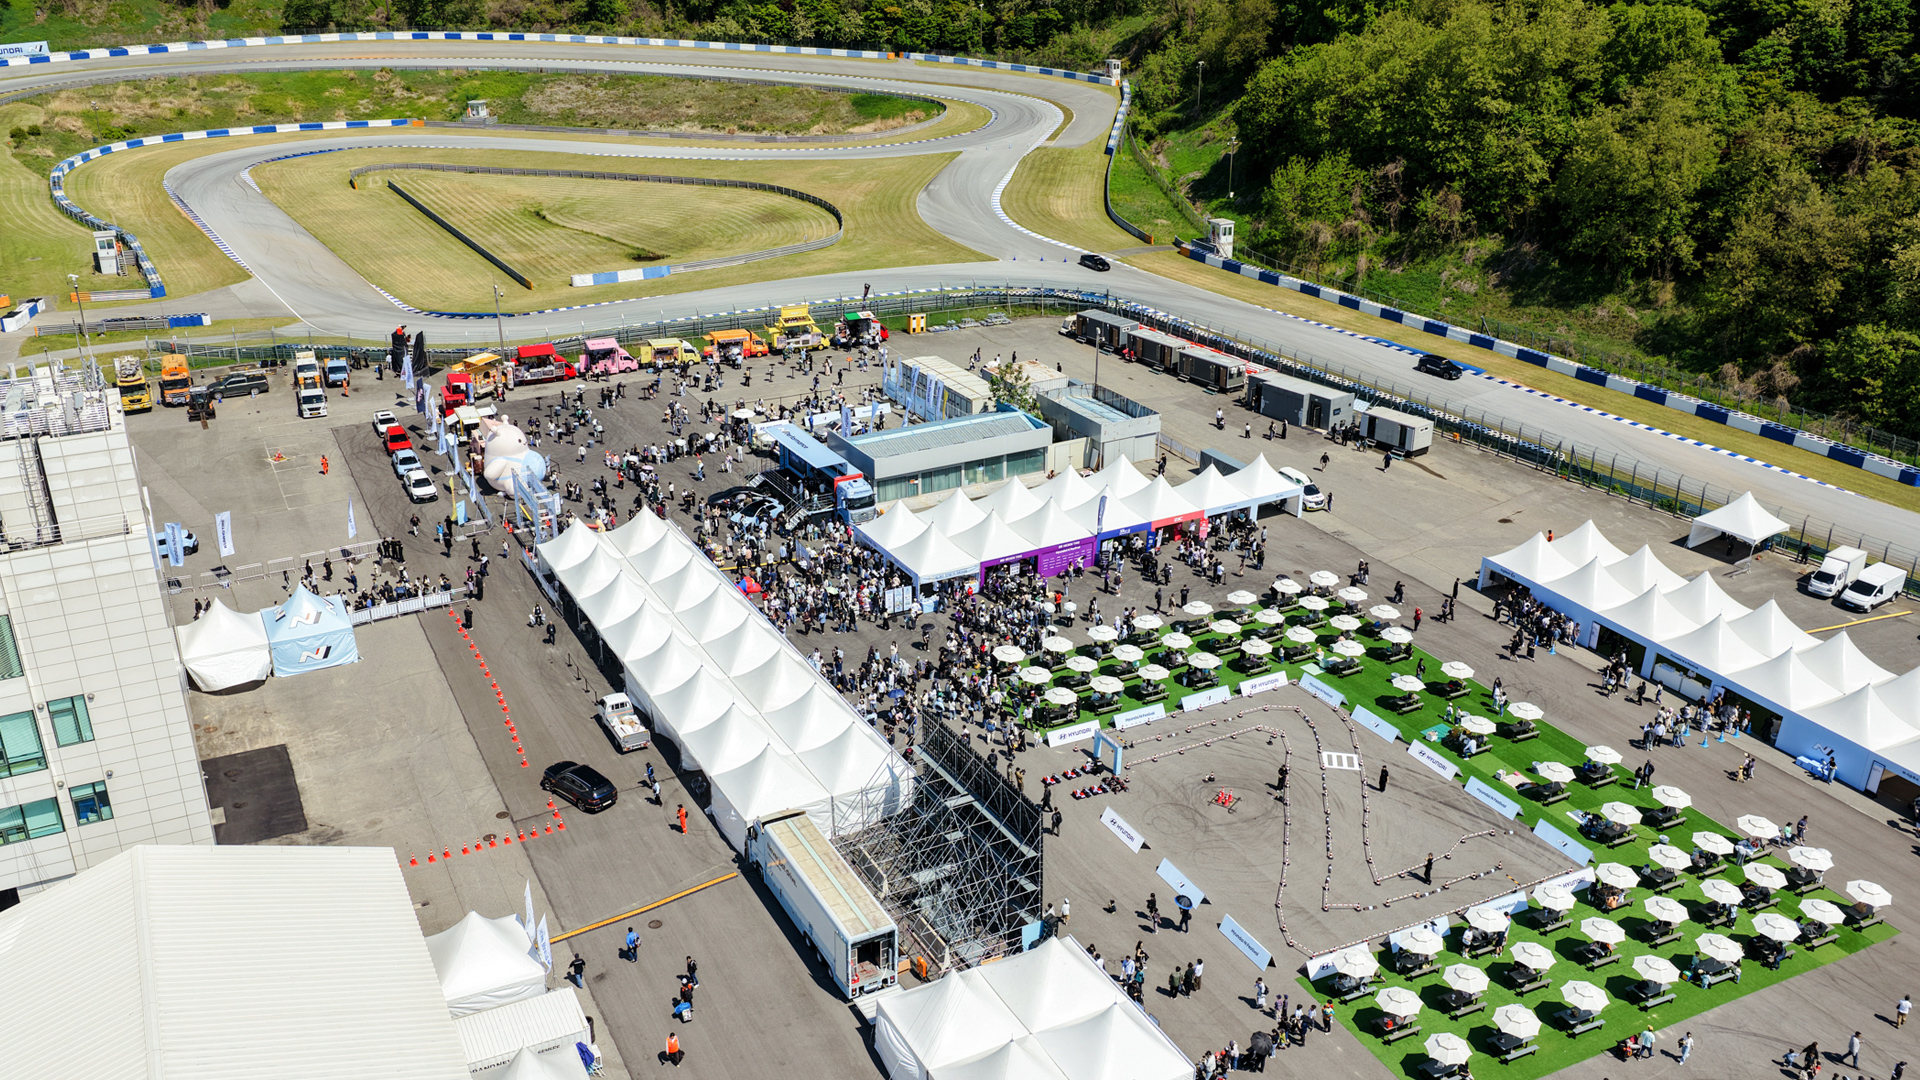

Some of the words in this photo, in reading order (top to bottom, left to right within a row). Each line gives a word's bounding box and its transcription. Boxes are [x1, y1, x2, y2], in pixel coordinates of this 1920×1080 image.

[1257, 677, 1280, 689] HYUNDAI
[1067, 727, 1092, 737] HYUNDAI
[1426, 754, 1448, 771] HYUNDAI
[1116, 824, 1135, 842] HYUNDAI
[1562, 876, 1586, 889] HYUNDAI
